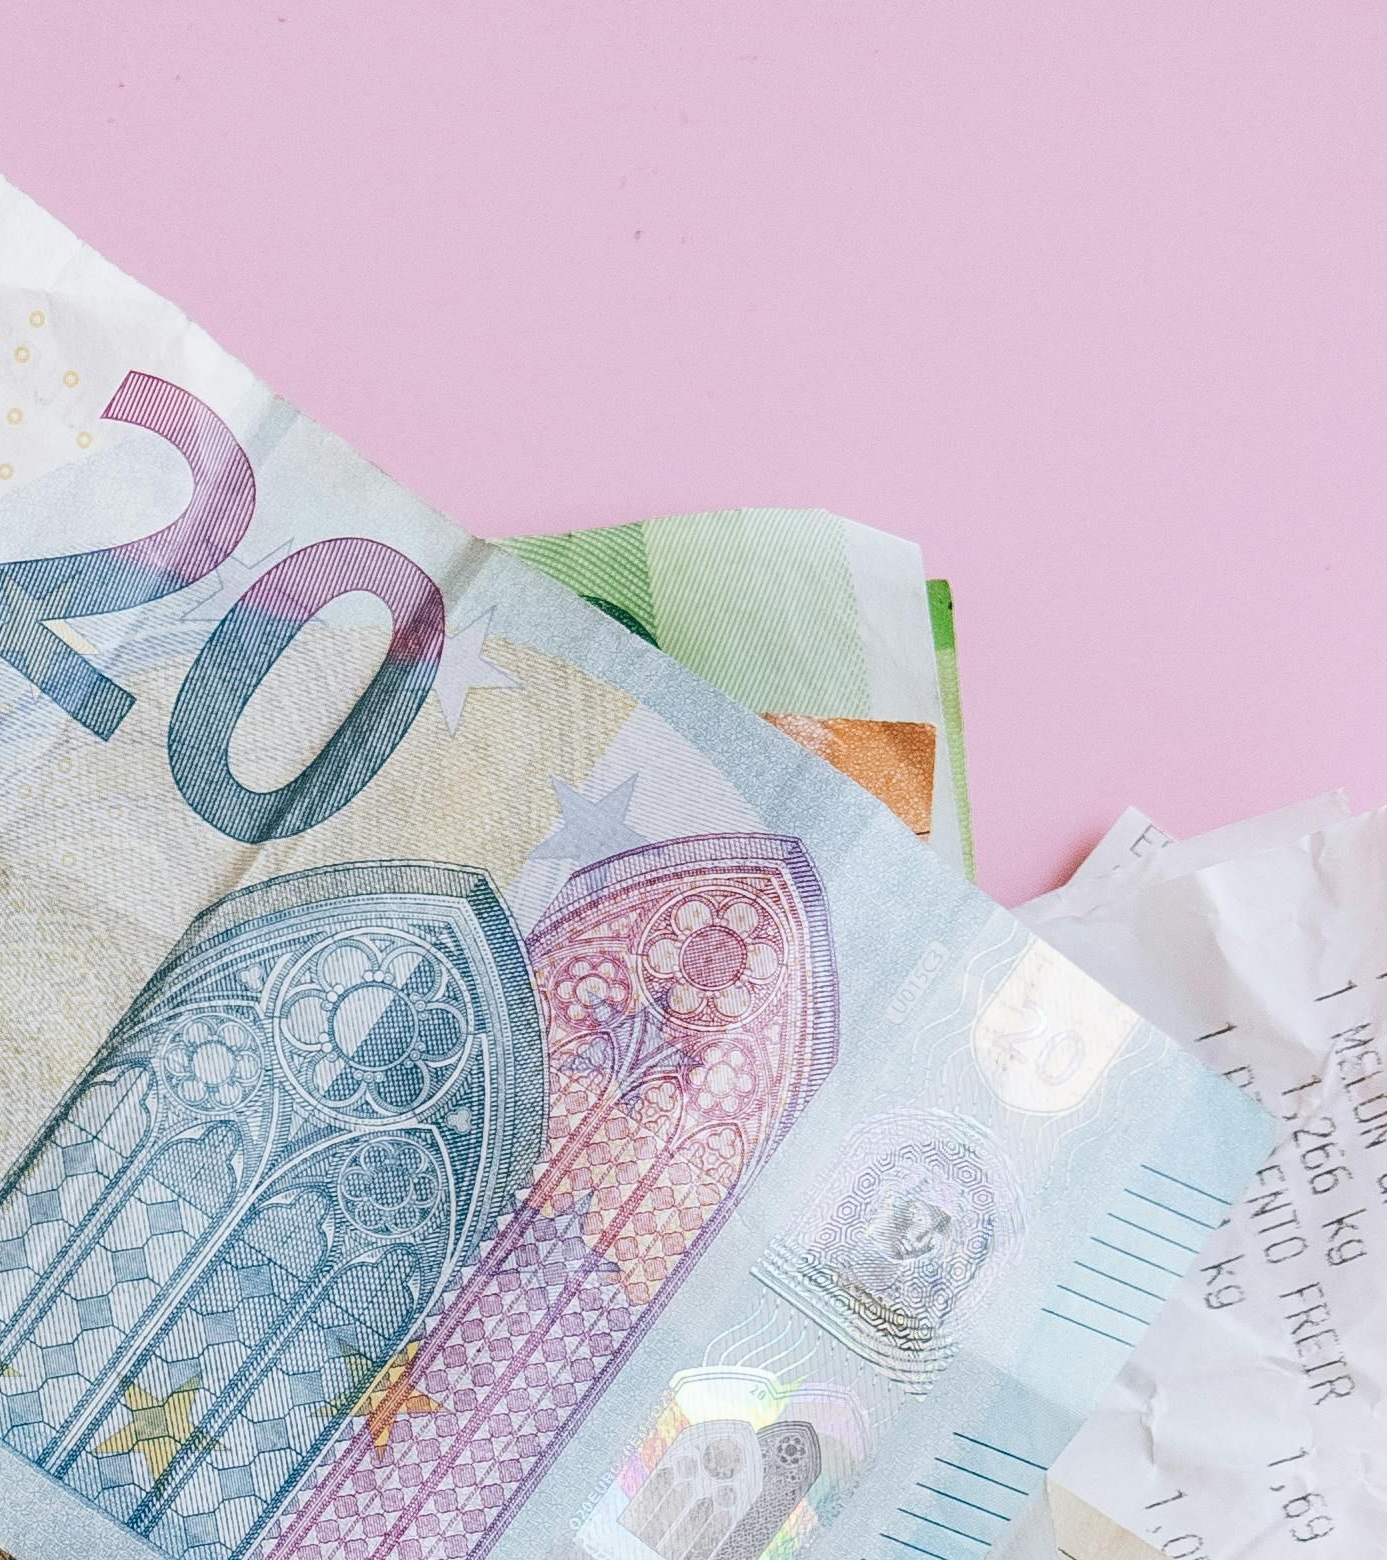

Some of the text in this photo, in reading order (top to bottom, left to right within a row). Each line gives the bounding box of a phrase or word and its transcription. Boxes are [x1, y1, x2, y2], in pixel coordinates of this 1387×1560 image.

[1280, 1073, 1369, 1268] 1,266 kg
[1267, 1449, 1335, 1544] 1,69
